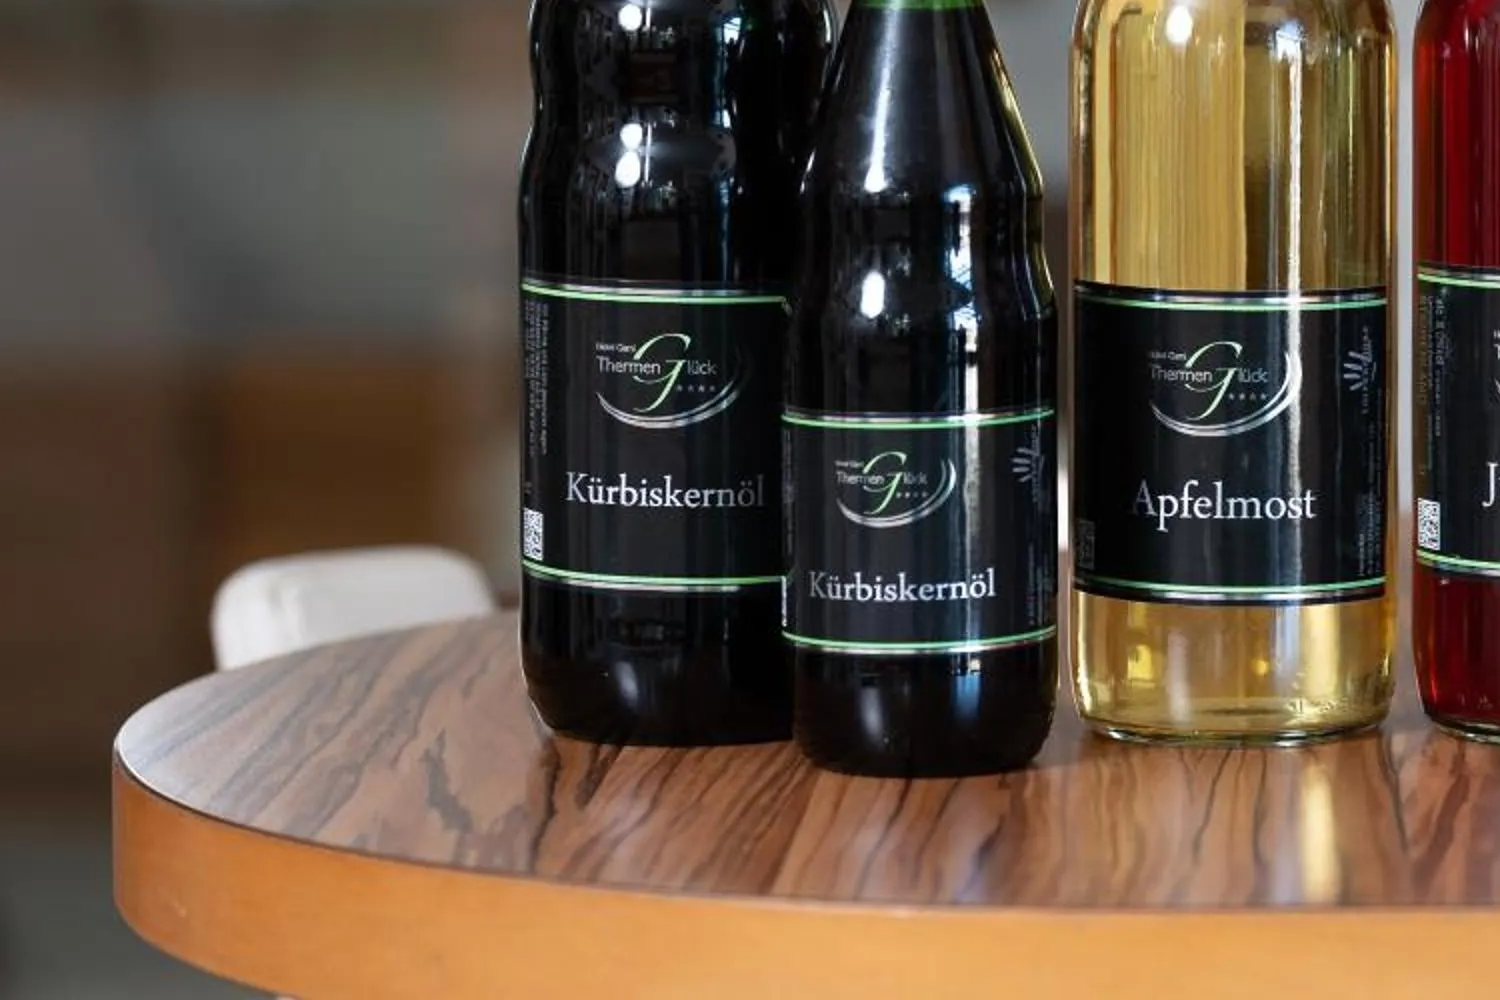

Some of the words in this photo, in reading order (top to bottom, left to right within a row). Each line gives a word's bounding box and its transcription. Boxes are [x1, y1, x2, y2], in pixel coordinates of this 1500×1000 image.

[566, 471, 764, 509] Kürbiskernöl
[1133, 480, 1316, 532] Apfelmost
[809, 567, 996, 602] Kürbiskernöl
